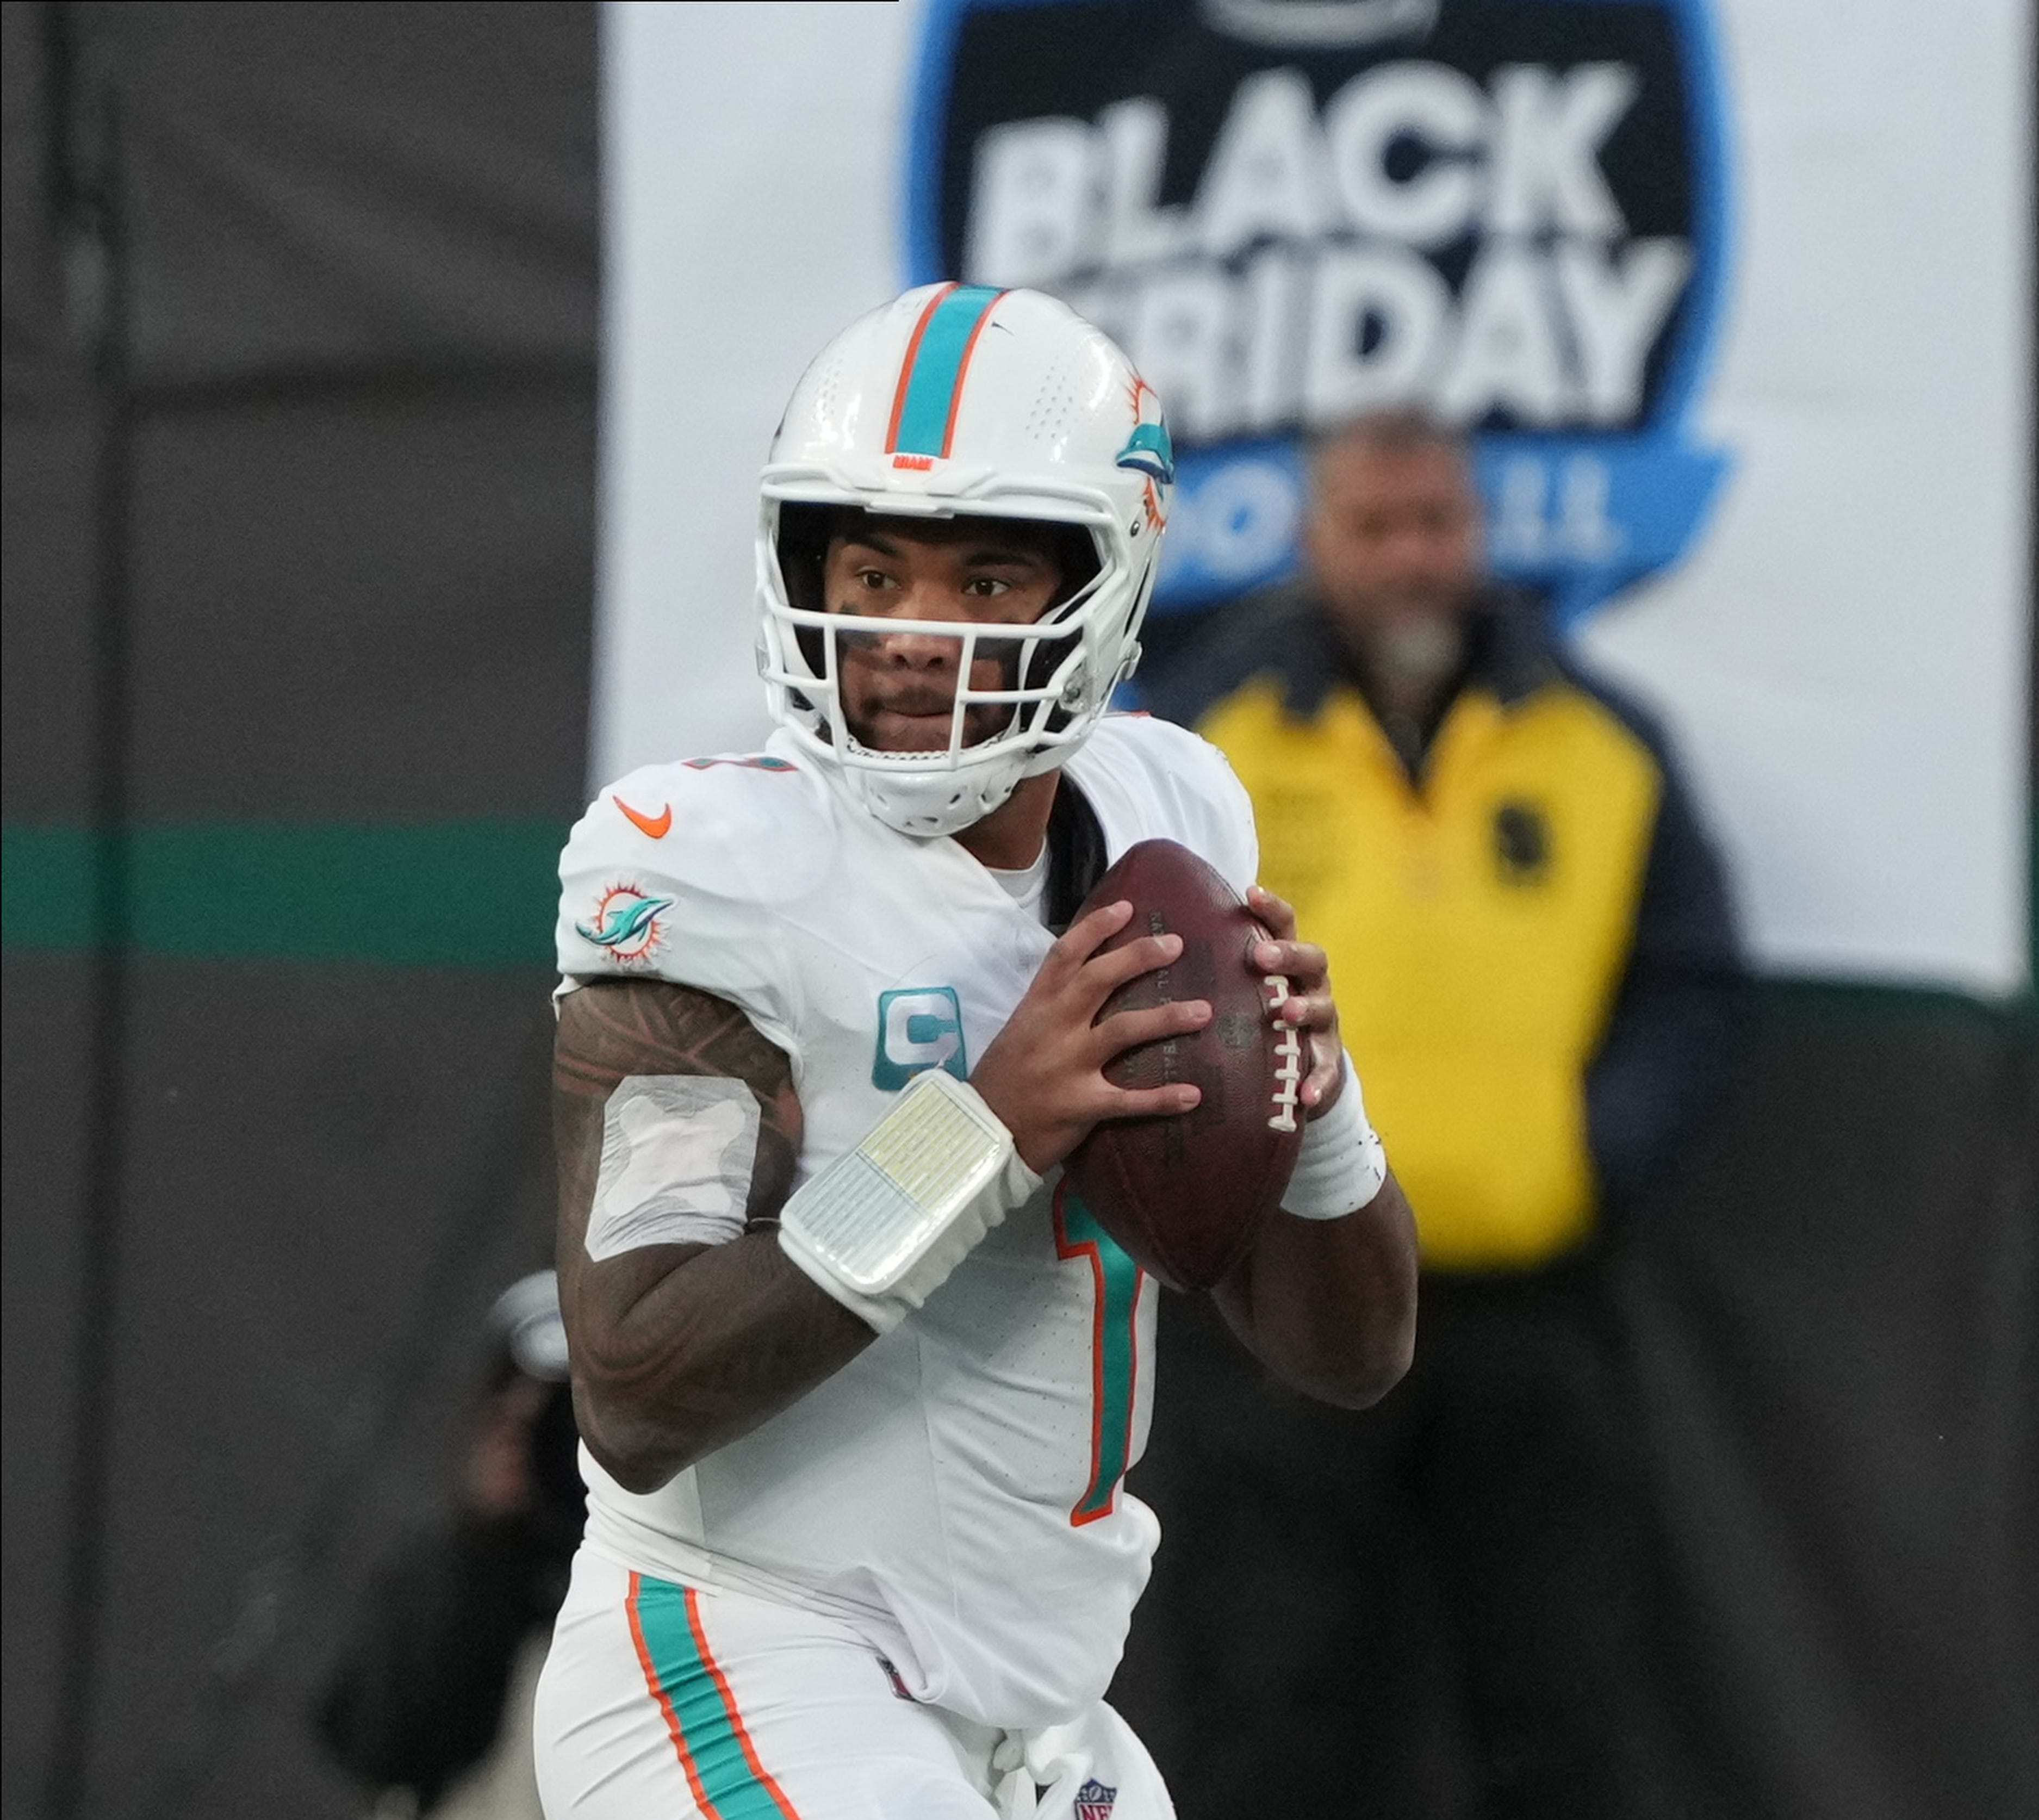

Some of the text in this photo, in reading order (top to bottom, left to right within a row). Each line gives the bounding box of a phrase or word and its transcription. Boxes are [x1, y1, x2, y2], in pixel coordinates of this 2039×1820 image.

[967, 61, 1637, 280] BLACK
[885, 992, 960, 1066] C
[1053, 1173, 1144, 1527] 1
[1078, 1804, 1112, 1820] NF
